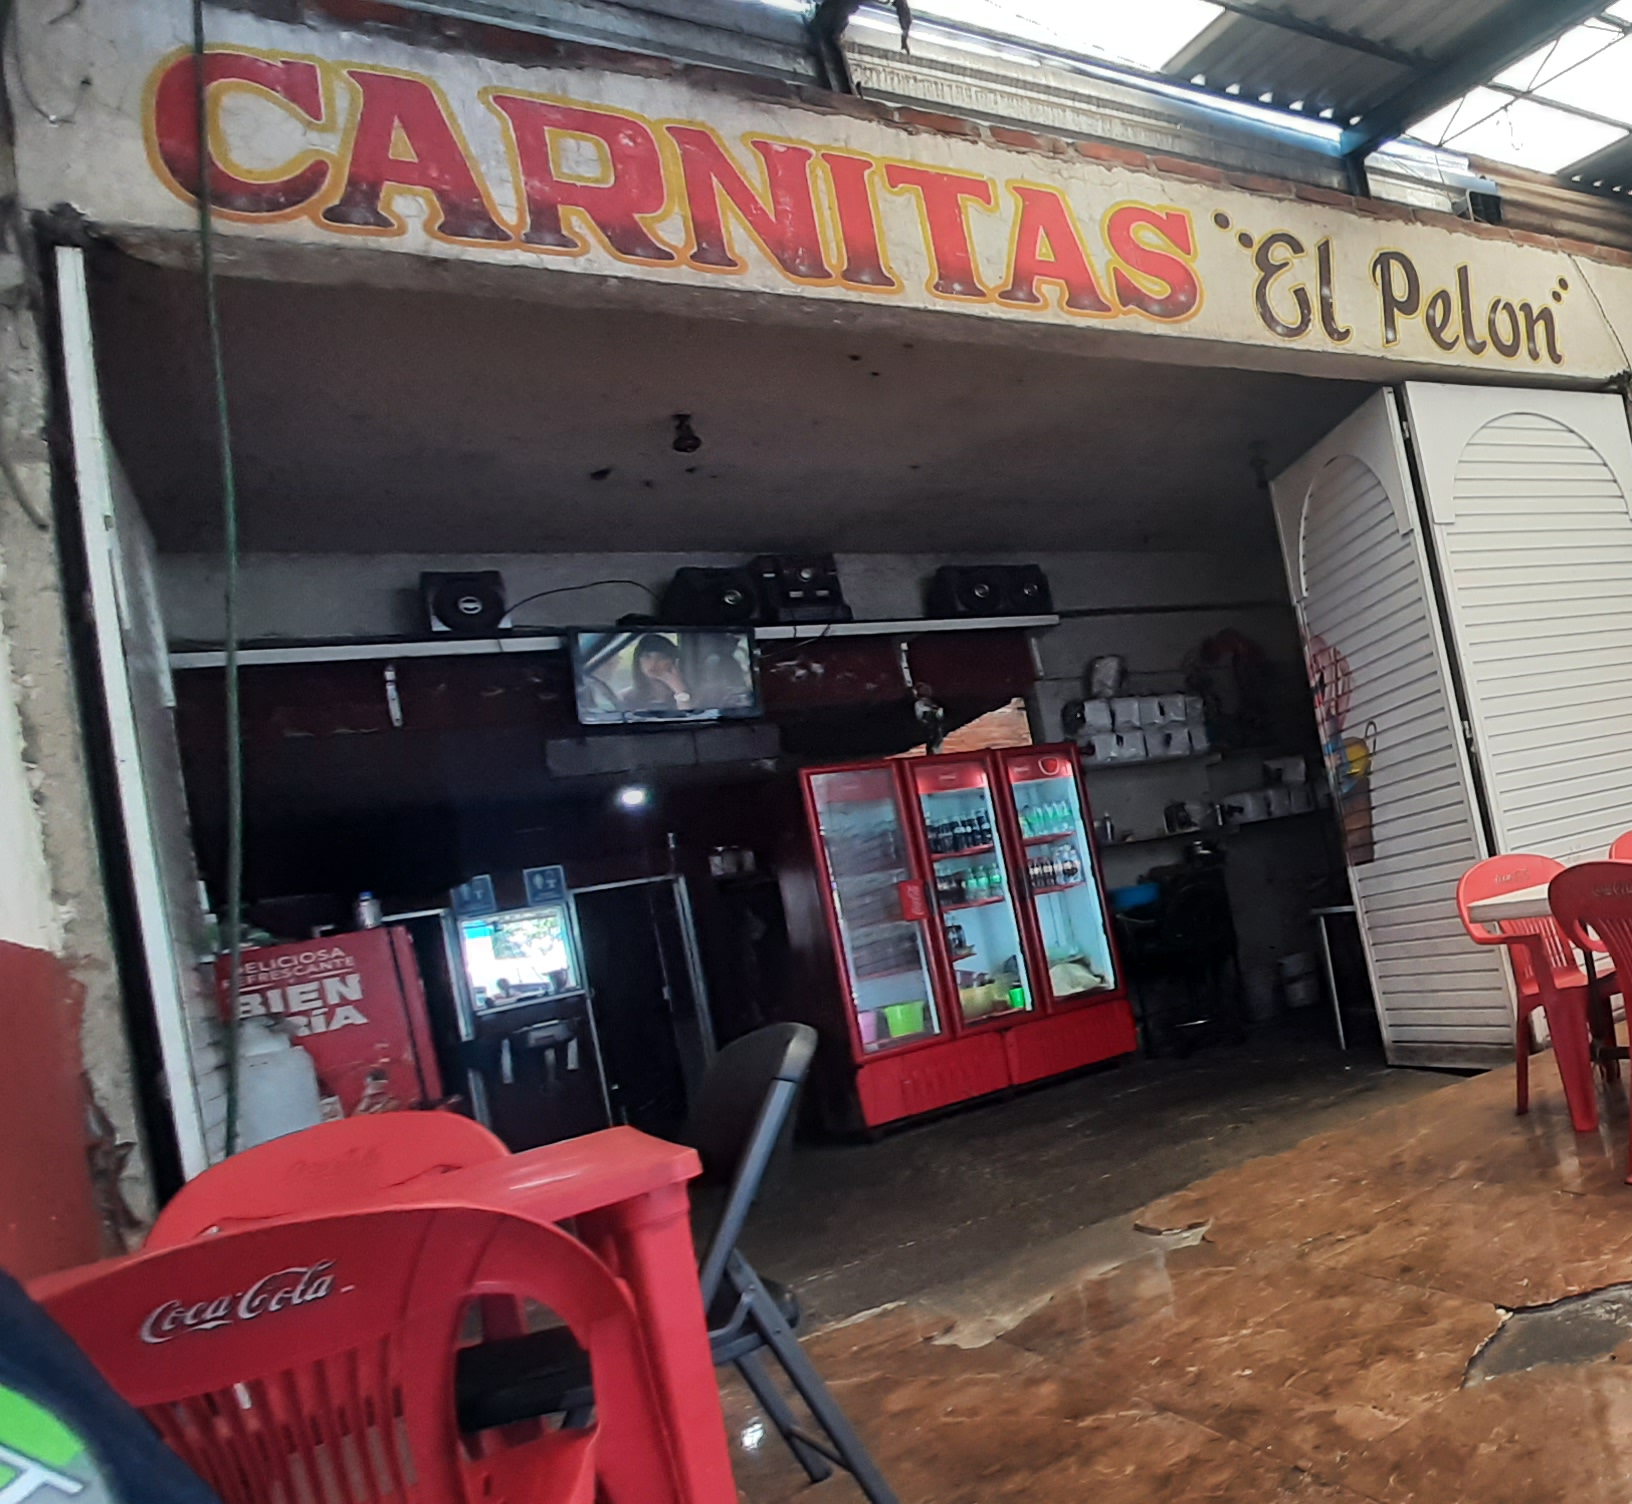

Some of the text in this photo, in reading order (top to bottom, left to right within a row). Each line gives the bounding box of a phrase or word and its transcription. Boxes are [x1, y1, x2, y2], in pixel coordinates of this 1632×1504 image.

[142, 42, 1204, 323] CARNITAS
[237, 947, 346, 975] ELICIOSA
[239, 974, 364, 1019] BIEN
[286, 1005, 369, 1037] RÍA
[140, 1258, 337, 1344] Coca-Cola
